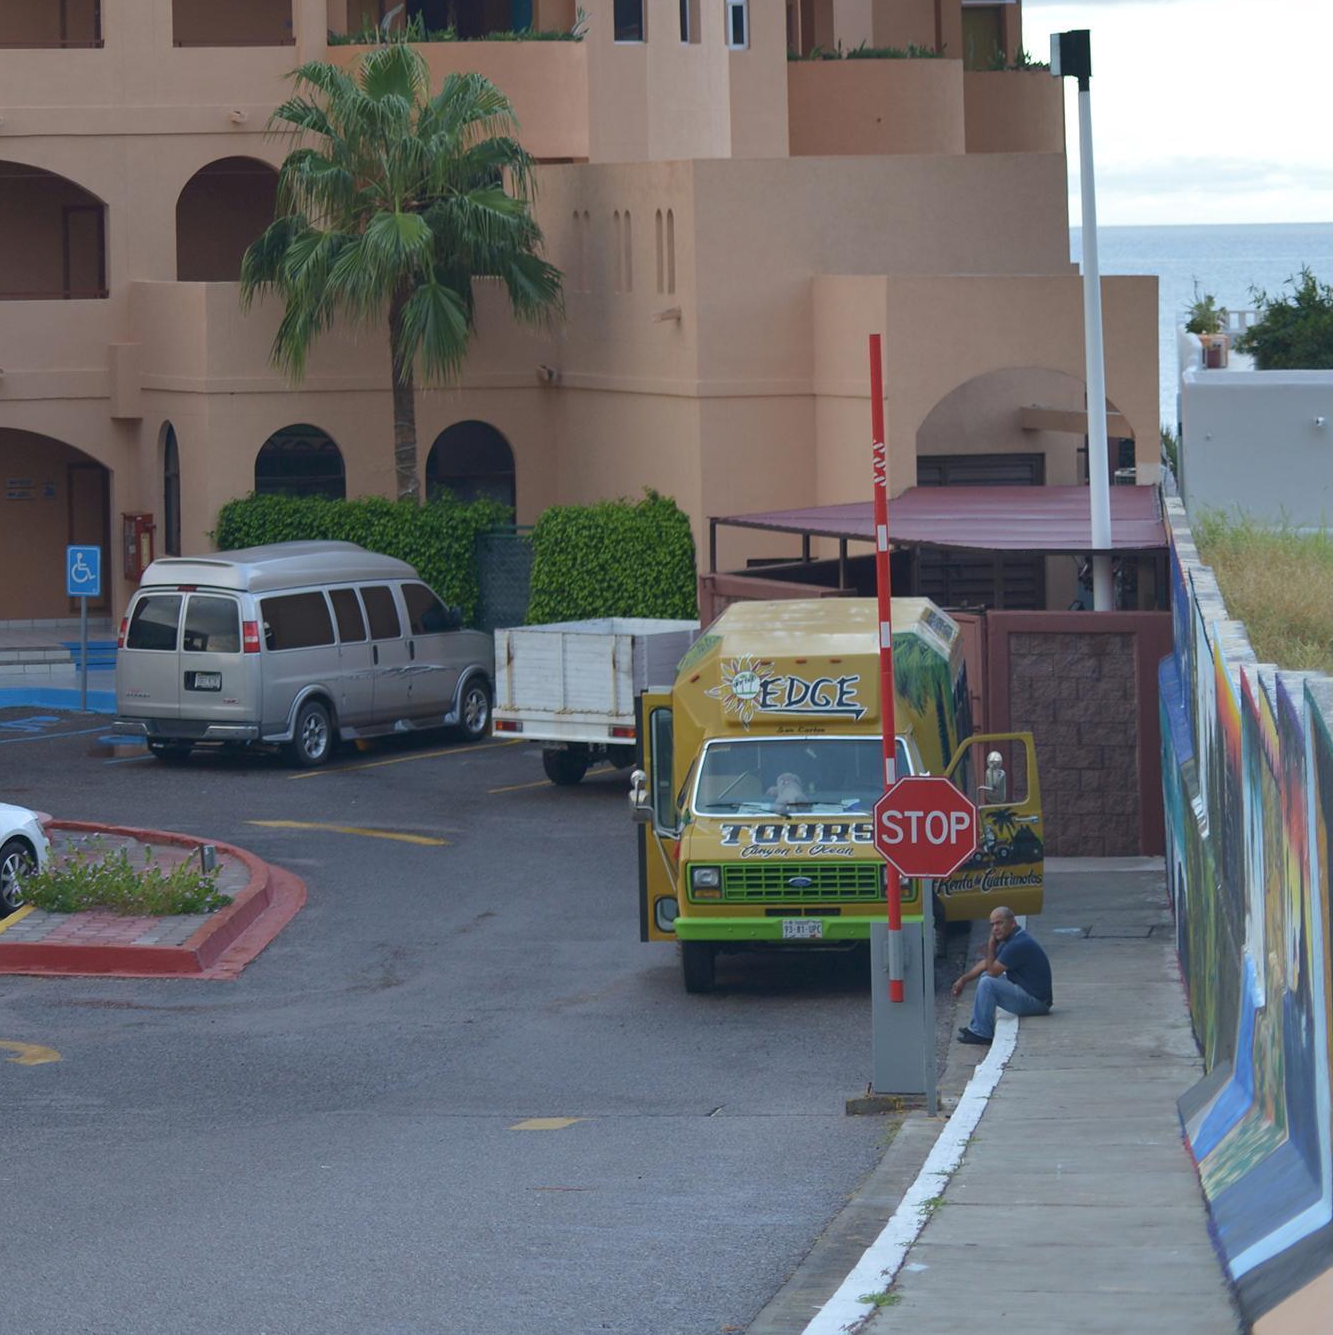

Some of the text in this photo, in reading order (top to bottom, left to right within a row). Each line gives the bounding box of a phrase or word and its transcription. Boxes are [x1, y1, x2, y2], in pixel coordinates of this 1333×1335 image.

[758, 675, 861, 709] EDGE
[719, 822, 874, 846] TOURS
[880, 809, 971, 846] STOP
[740, 844, 791, 858] Canyon
[808, 844, 854, 858] Ocean
